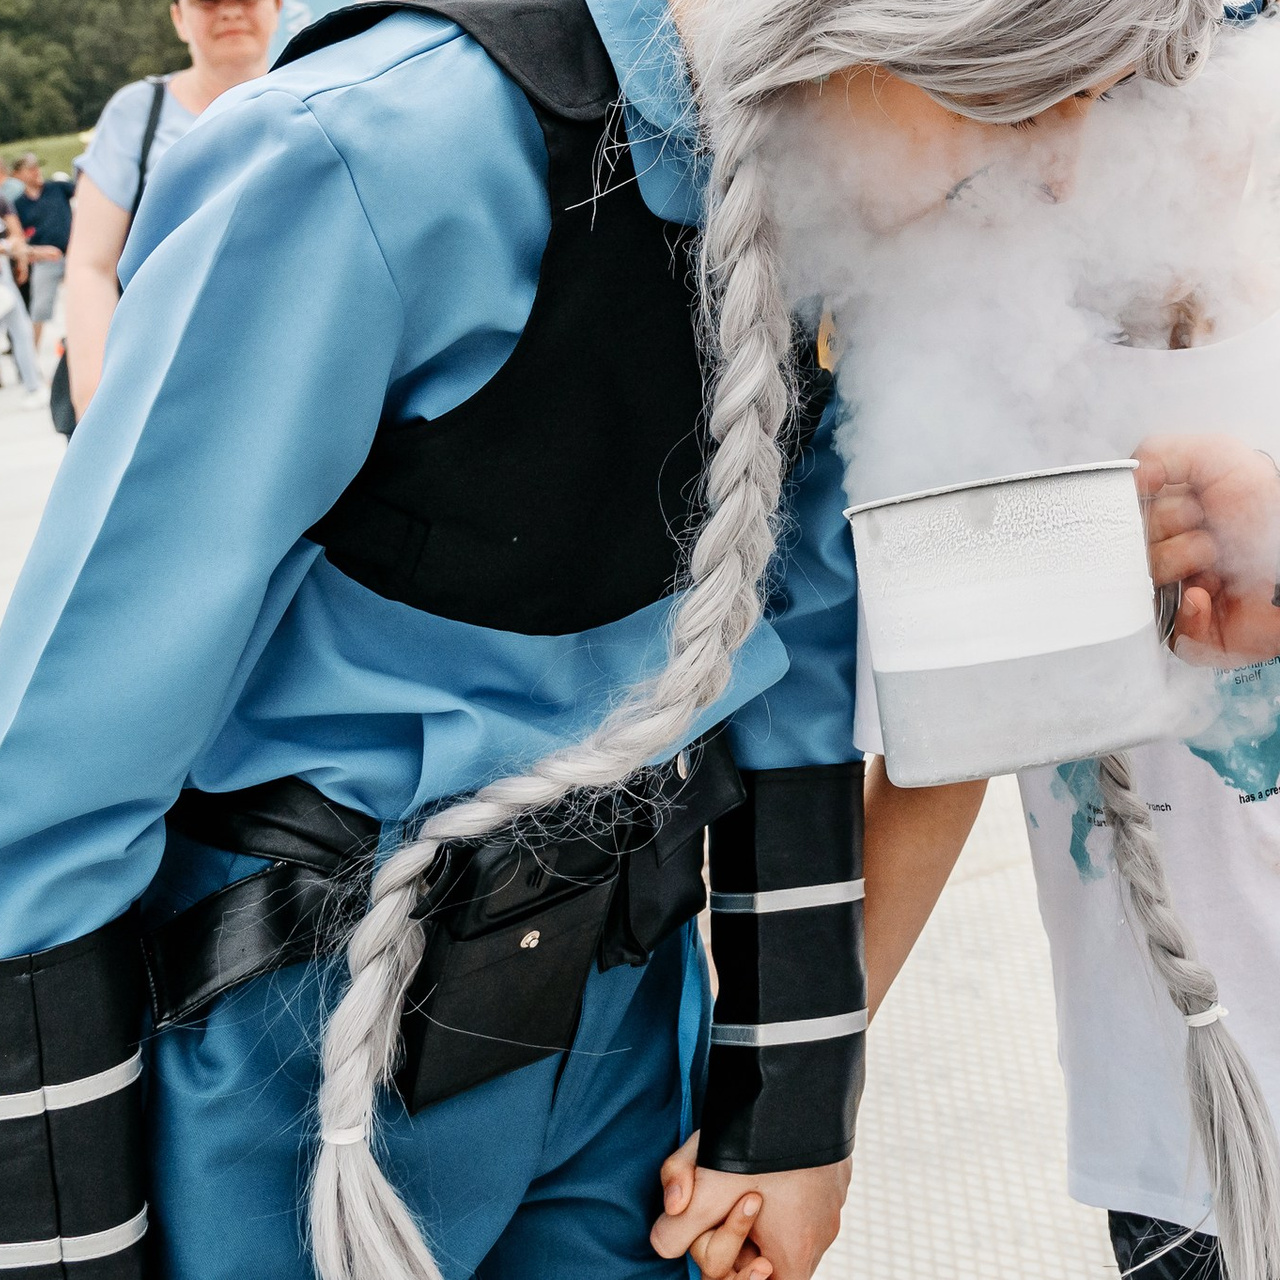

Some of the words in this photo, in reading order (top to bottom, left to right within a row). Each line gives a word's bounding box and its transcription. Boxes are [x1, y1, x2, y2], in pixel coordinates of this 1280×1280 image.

[1234, 669, 1262, 685] shelf
[1239, 792, 1256, 805] has
[1258, 790, 1264, 800] a
